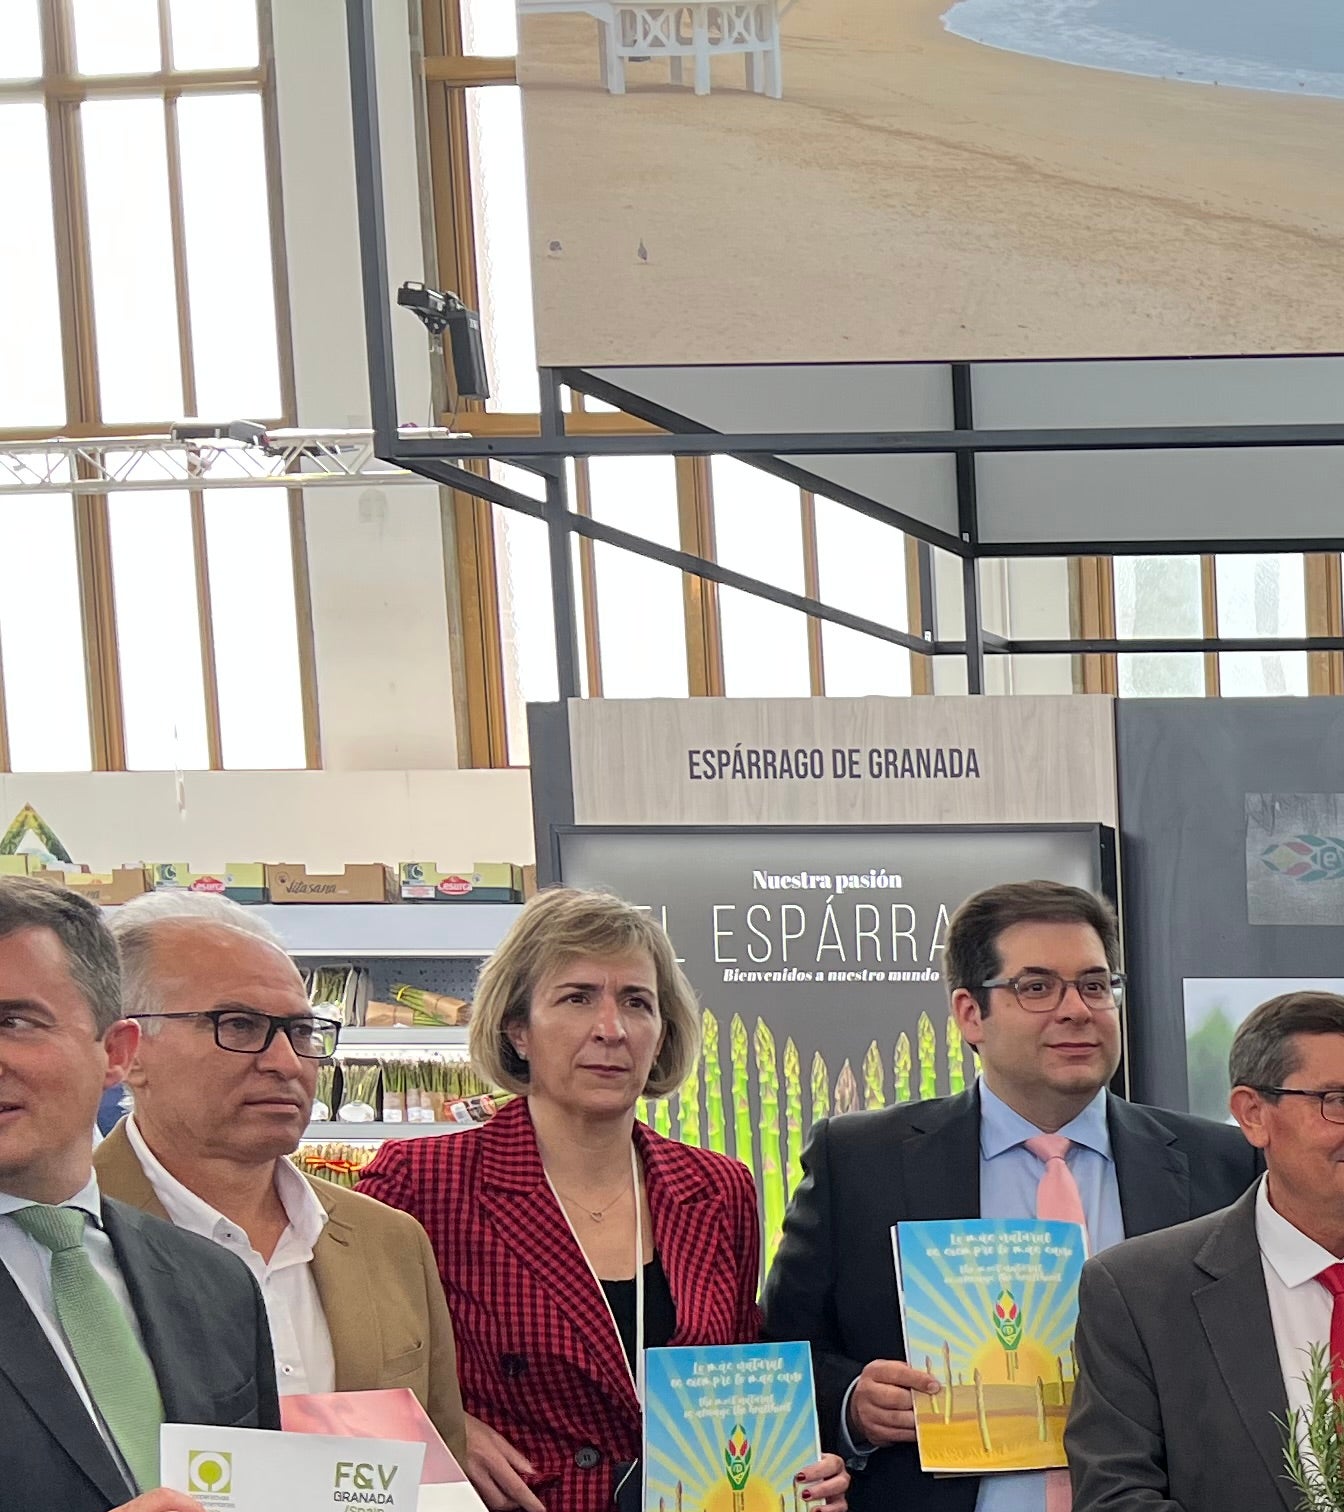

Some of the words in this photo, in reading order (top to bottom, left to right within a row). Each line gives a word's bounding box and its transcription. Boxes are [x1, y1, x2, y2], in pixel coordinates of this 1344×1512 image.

[688, 742, 824, 780] ESPÁRRAGO
[832, 749, 861, 780] DE
[868, 747, 980, 780] GRANADA
[752, 870, 832, 890] Nuestra
[835, 868, 902, 894] pasión
[712, 895, 951, 963] ESPÁRRA
[723, 968, 813, 983] Bienvenidos
[815, 972, 824, 983] a
[827, 970, 885, 983] nuestro
[888, 967, 940, 983] mundo
[334, 1461, 399, 1491] F&V
[333, 1490, 394, 1505] GRANADA
